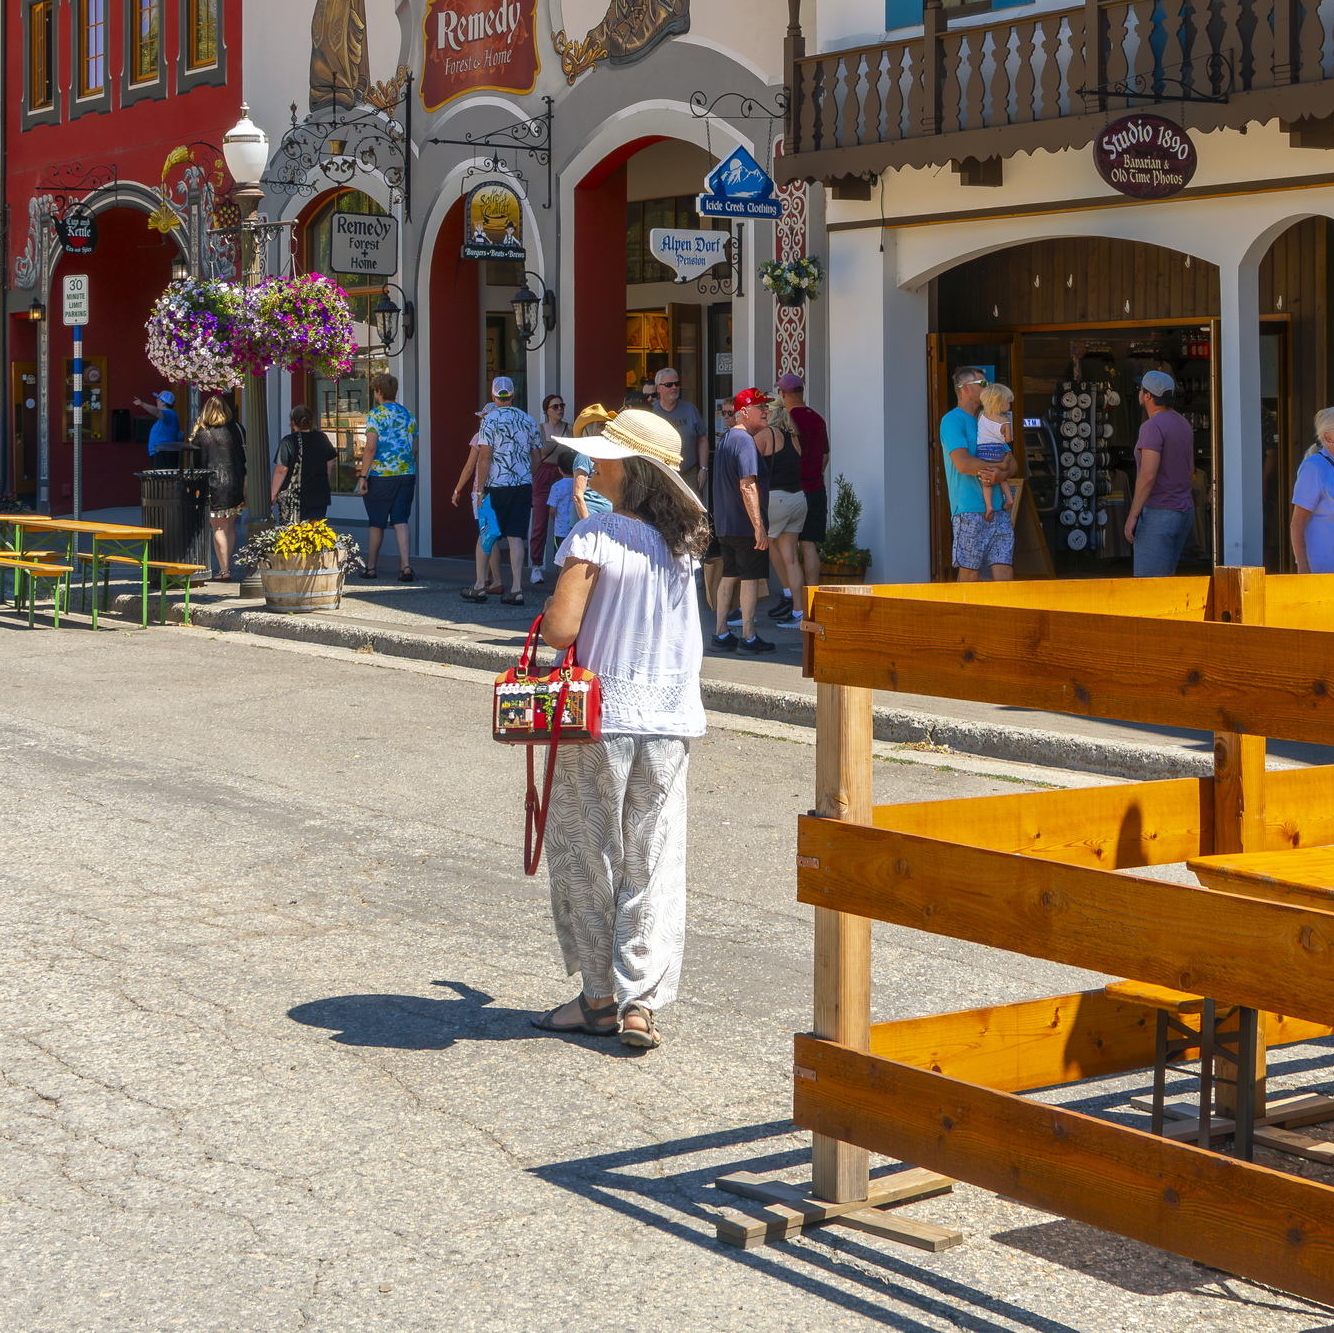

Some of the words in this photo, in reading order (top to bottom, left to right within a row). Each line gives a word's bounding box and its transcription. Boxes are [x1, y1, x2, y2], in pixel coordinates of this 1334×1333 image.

[445, 55, 472, 75] Forest
[473, 57, 481, 69] &
[482, 46, 513, 68] Home
[1103, 119, 1153, 160] Studio
[1157, 126, 1189, 160] 1890
[1123, 154, 1162, 169] Bavarian
[1163, 160, 1170, 169] &
[1111, 168, 1128, 182] Old
[1129, 169, 1151, 183] Time
[1152, 170, 1183, 186] Photos
[705, 200, 723, 211] Icicle
[725, 201, 745, 212] Creek
[747, 203, 777, 216] Clothing
[66, 218, 80, 230] Cup
[337, 215, 391, 241] Remedy
[66, 226, 92, 237] Kettle
[349, 236, 380, 250] Forest
[660, 234, 692, 254] Alpen
[694, 236, 721, 253] Dorf
[464, 247, 487, 258] Burgers
[507, 250, 525, 258] Brews
[350, 256, 378, 270] Home
[676, 253, 706, 267] Pension
[69, 279, 83, 291] 30
[66, 292, 86, 301] MINUTE
[68, 301, 83, 309] LIMIT
[64, 310, 87, 318] PARKING
[718, 364, 734, 372] OPE
